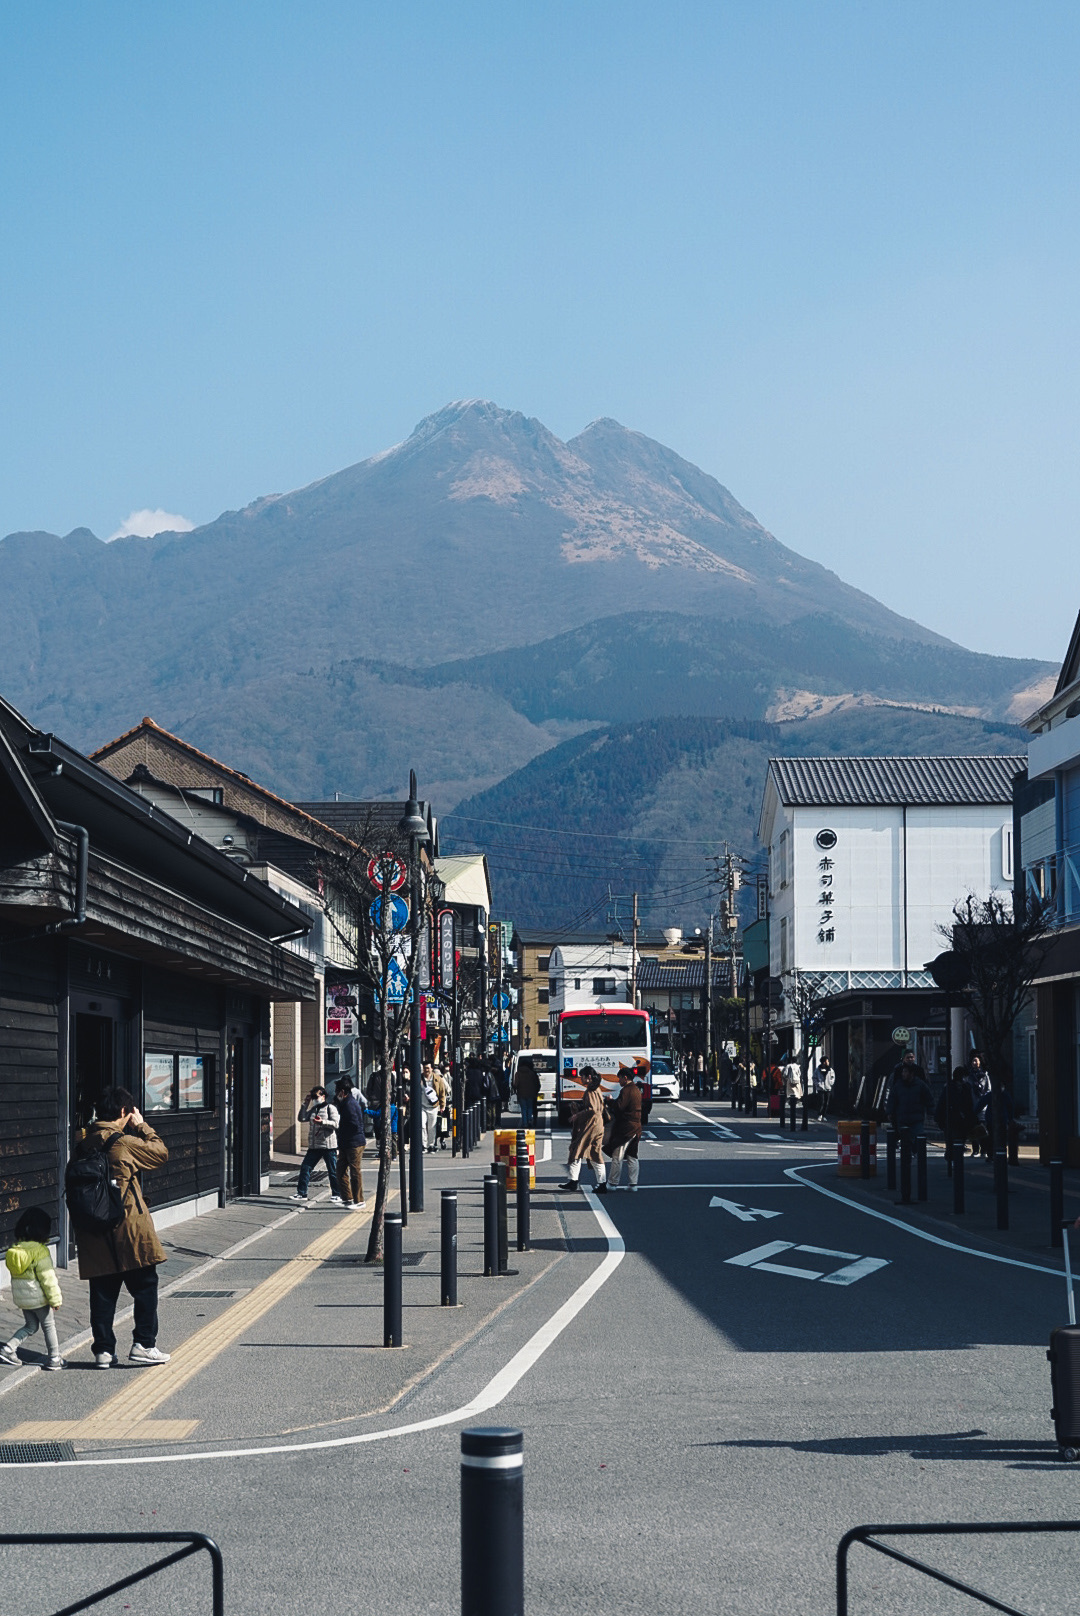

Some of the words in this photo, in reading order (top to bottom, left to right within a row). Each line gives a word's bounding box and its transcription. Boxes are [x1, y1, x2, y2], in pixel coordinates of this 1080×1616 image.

[818, 856, 836, 943] 赤司菓子舗
[443, 918, 453, 973] バスのりば
